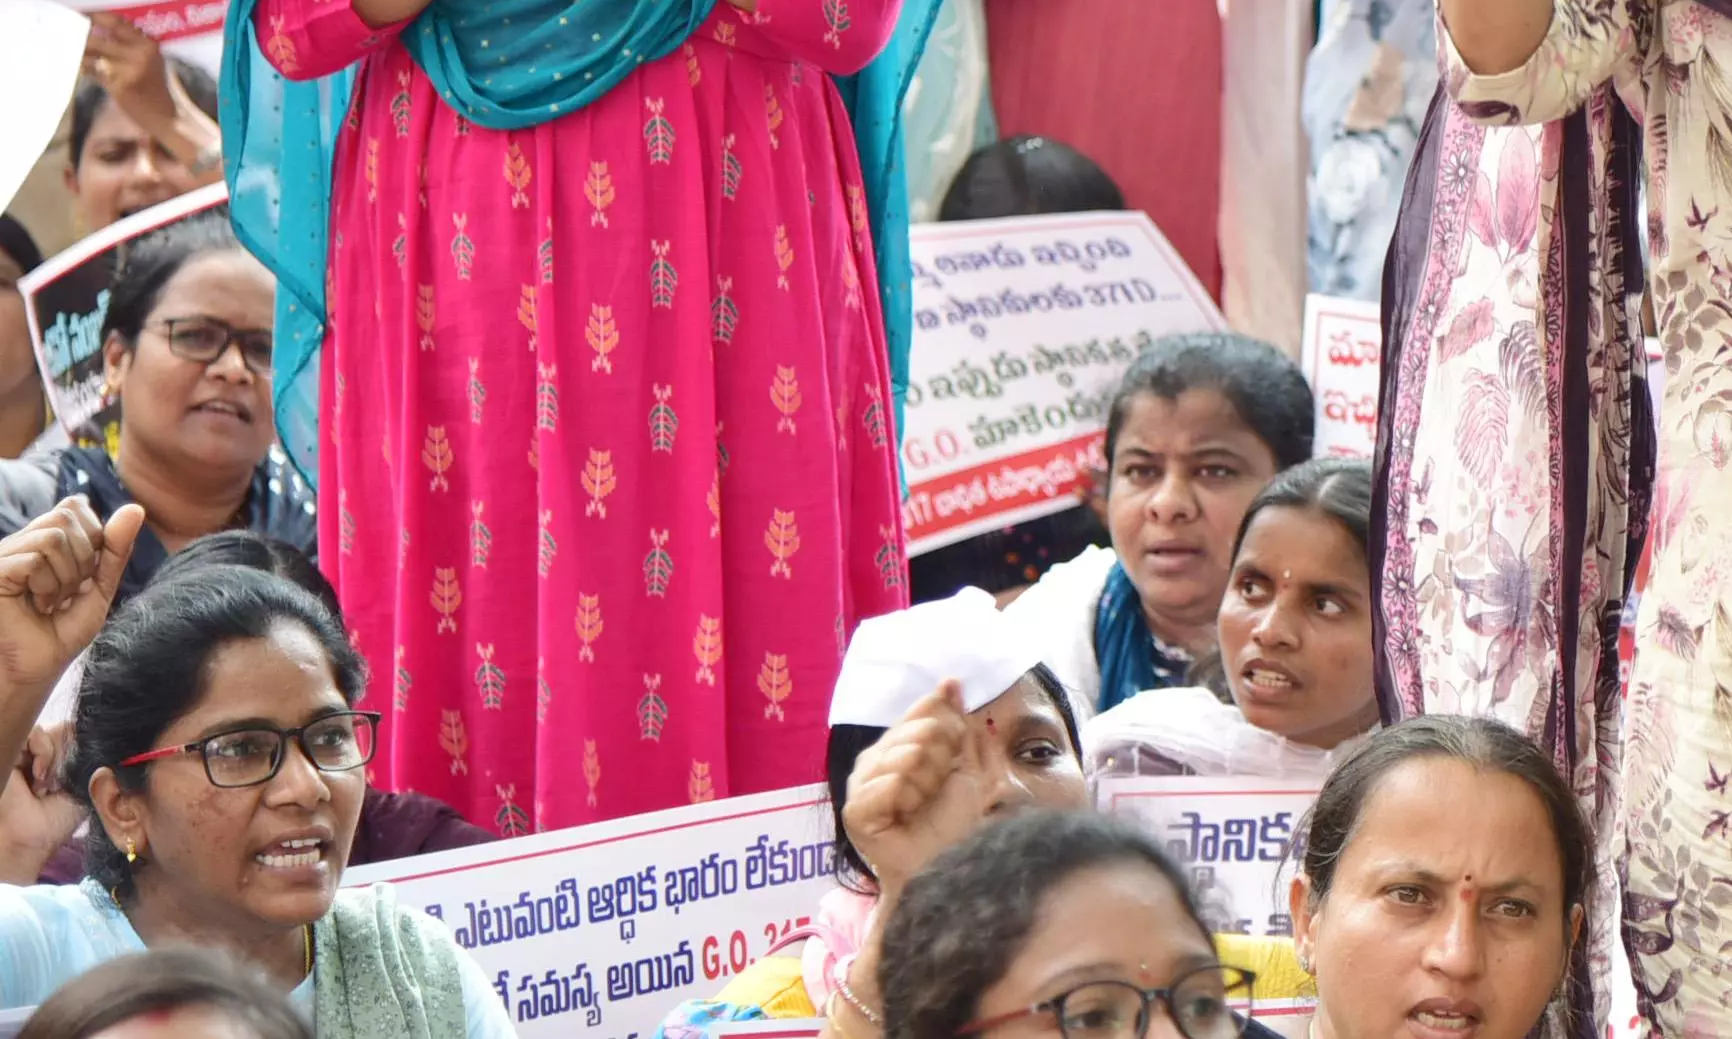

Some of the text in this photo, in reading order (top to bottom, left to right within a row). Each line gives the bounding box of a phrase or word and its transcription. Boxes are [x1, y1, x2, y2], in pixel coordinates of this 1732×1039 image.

[455, 878, 581, 949] ఎటువంటి
[664, 853, 738, 914] భారం
[517, 963, 601, 1027] సమస్య
[607, 940, 694, 1002] అయిన
[702, 929, 755, 980] G.O.
